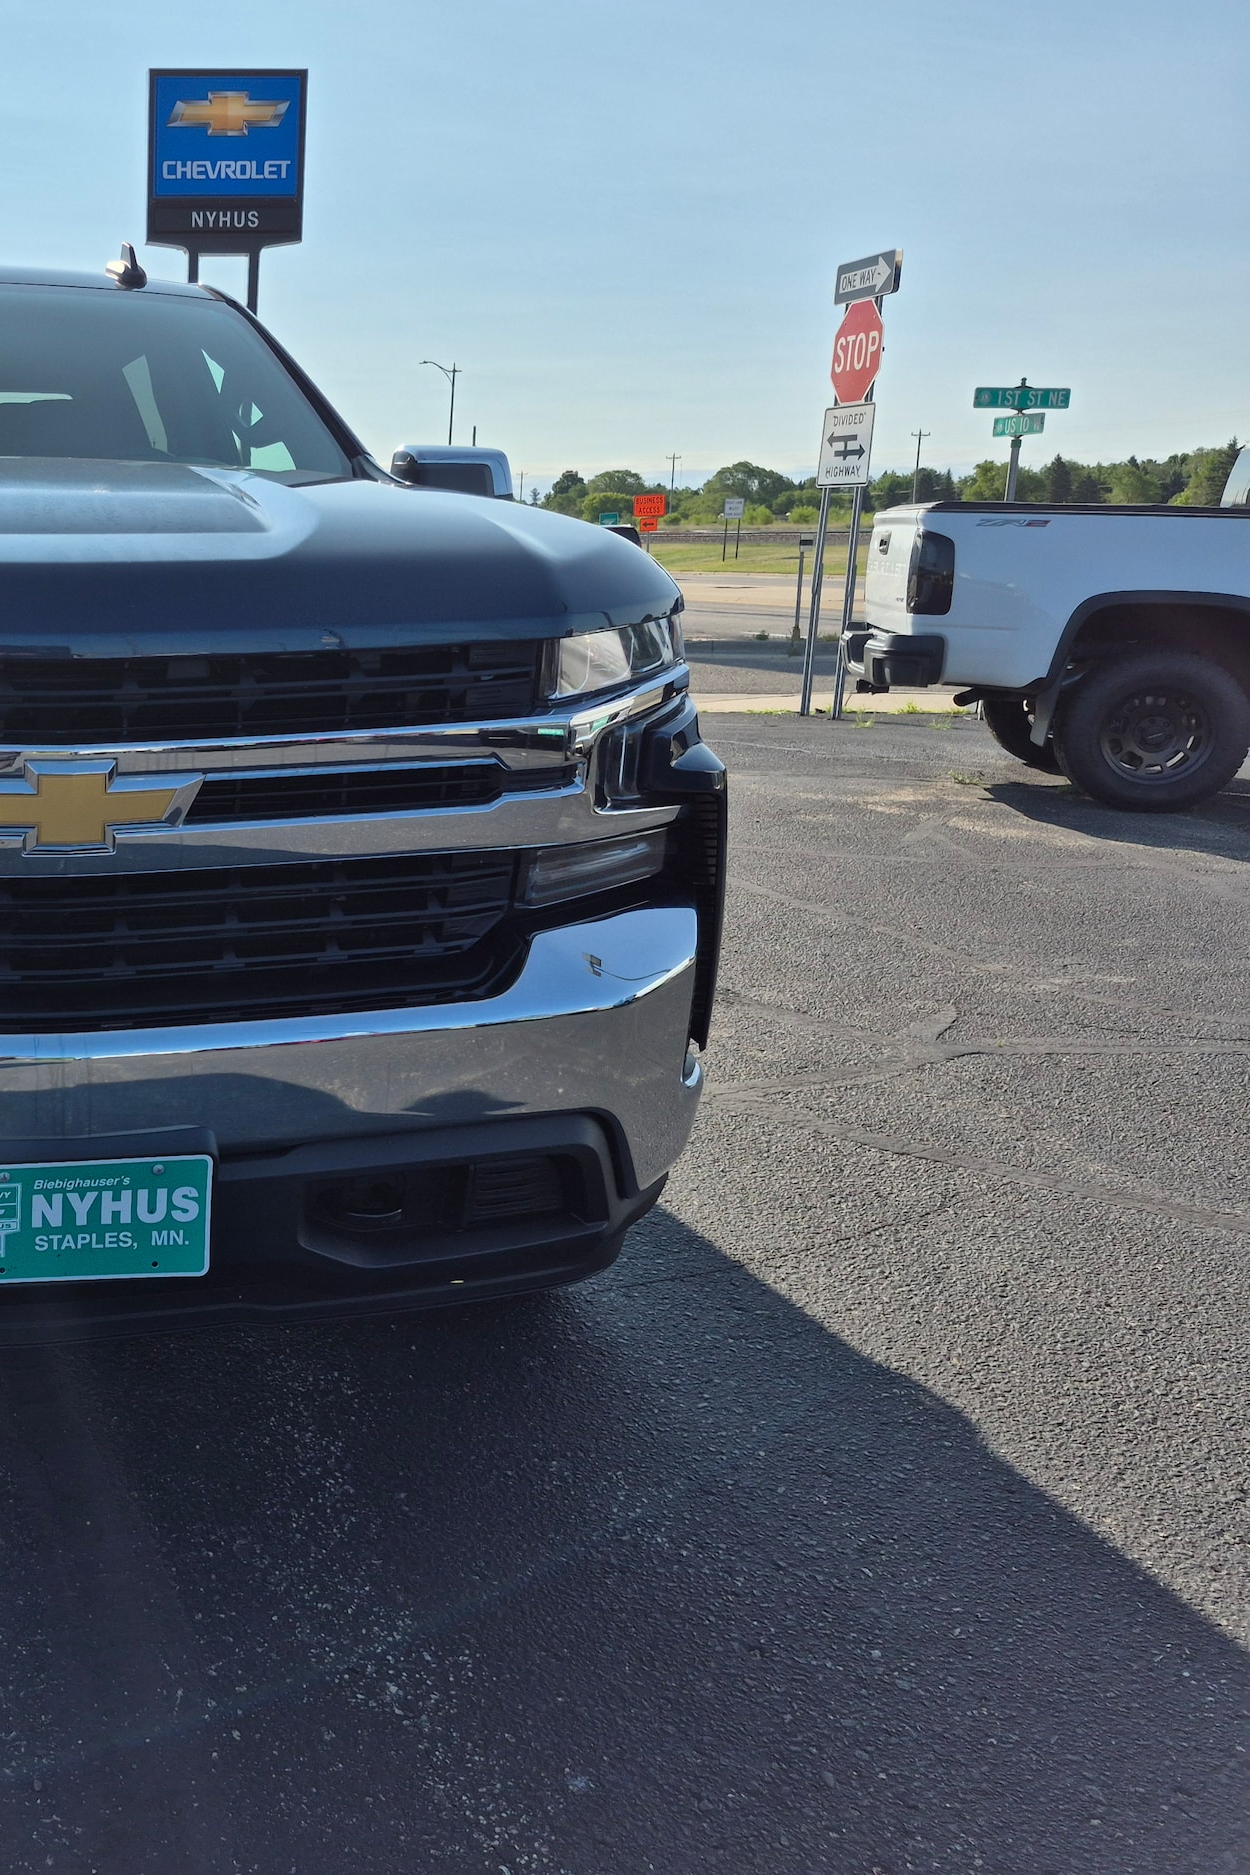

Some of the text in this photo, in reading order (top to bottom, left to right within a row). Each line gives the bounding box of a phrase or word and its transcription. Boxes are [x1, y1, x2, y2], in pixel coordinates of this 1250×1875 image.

[162, 160, 291, 180] CHEVROLET
[191, 211, 259, 228] NYHUS
[841, 267, 877, 291] ONE WAY
[834, 331, 879, 374] STOP
[998, 391, 1067, 406] 1ST ST NE
[833, 413, 864, 427] DIVIDED
[1005, 418, 1016, 433] US
[1020, 416, 1030, 432] 10
[825, 465, 861, 479] HIGHWAY
[636, 496, 664, 504] BUSINESS
[639, 506, 661, 514] ACCESS
[33, 1175, 131, 1190] Biebighauser's
[31, 1186, 199, 1228] NYHUS
[34, 1229, 190, 1252] STAPLES, MN.
